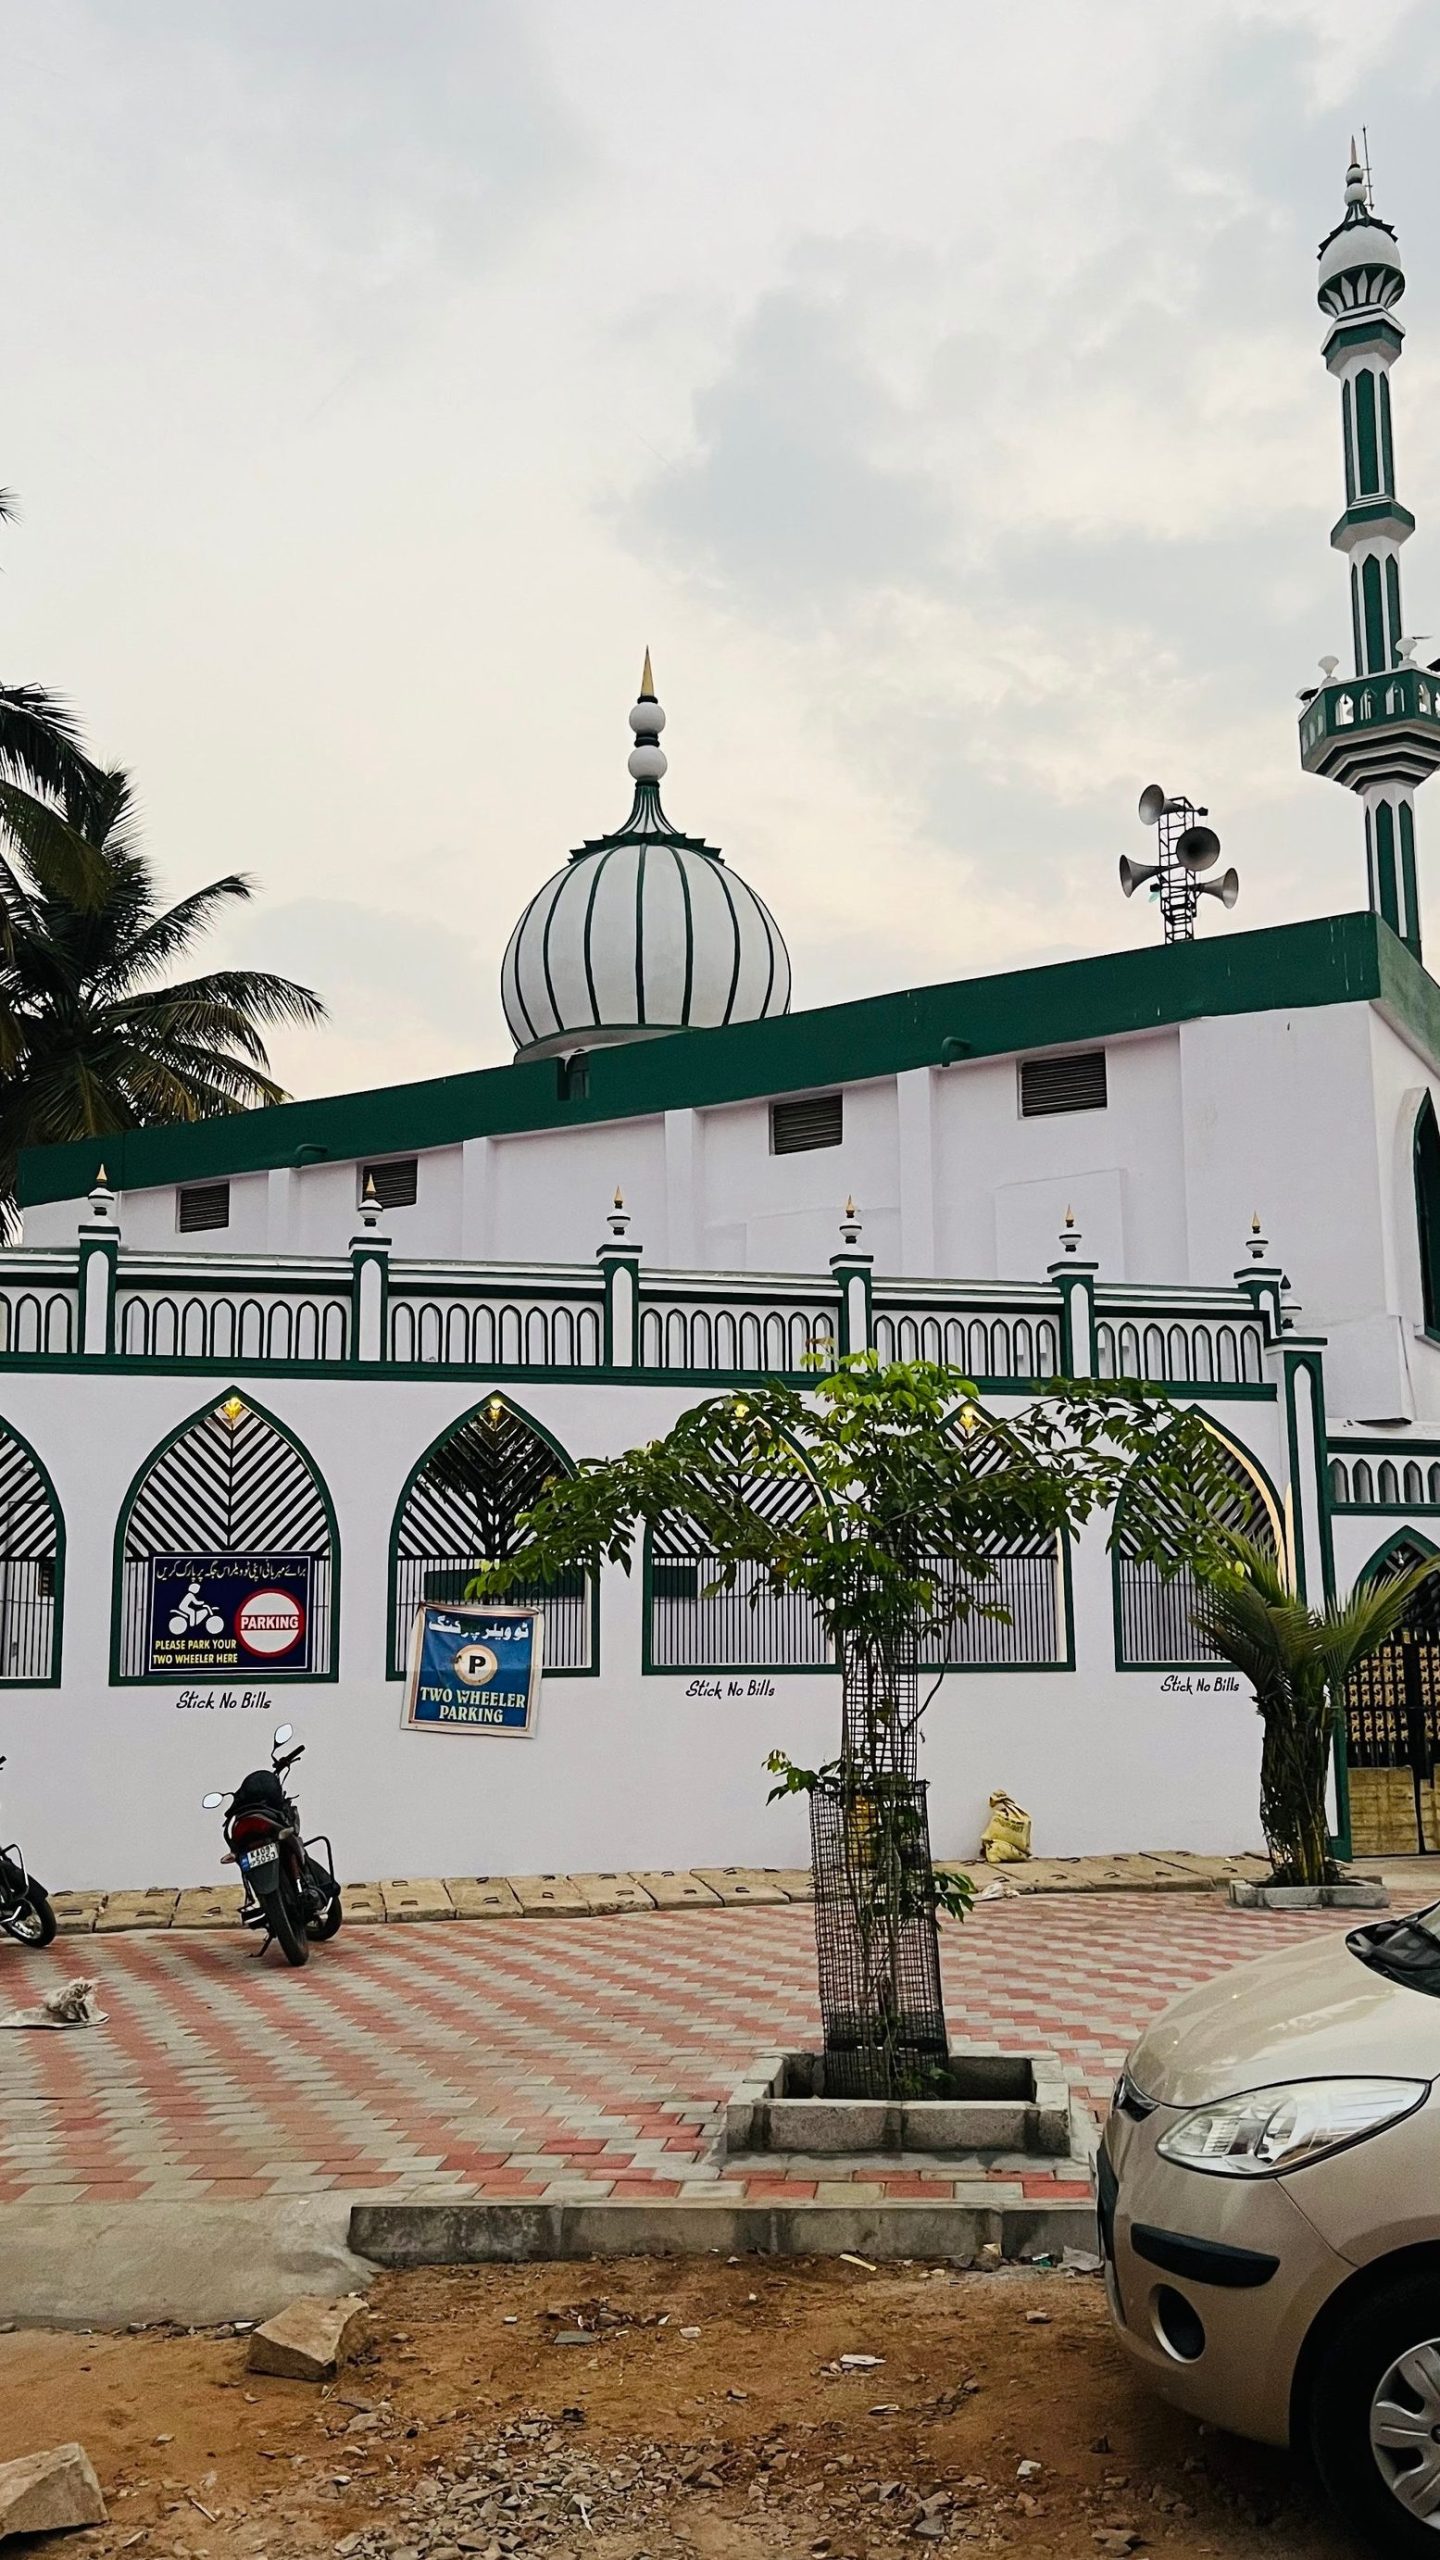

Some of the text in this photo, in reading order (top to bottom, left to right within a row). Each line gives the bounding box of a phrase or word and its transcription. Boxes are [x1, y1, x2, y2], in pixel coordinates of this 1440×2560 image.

[241, 1616, 299, 1629] PARKING
[155, 1639, 237, 1650] PLEASE PARK YOUR
[153, 1653, 238, 1664] TWO WHEELER HERE
[468, 1656, 486, 1674] P
[685, 1679, 775, 1700] Stick No Bills
[1160, 1674, 1240, 1695] Stick No Bills
[176, 1691, 272, 1709] Stick No Bills
[420, 1687, 526, 1708] TWO WHEELER
[439, 1705, 503, 1723] PARKING
